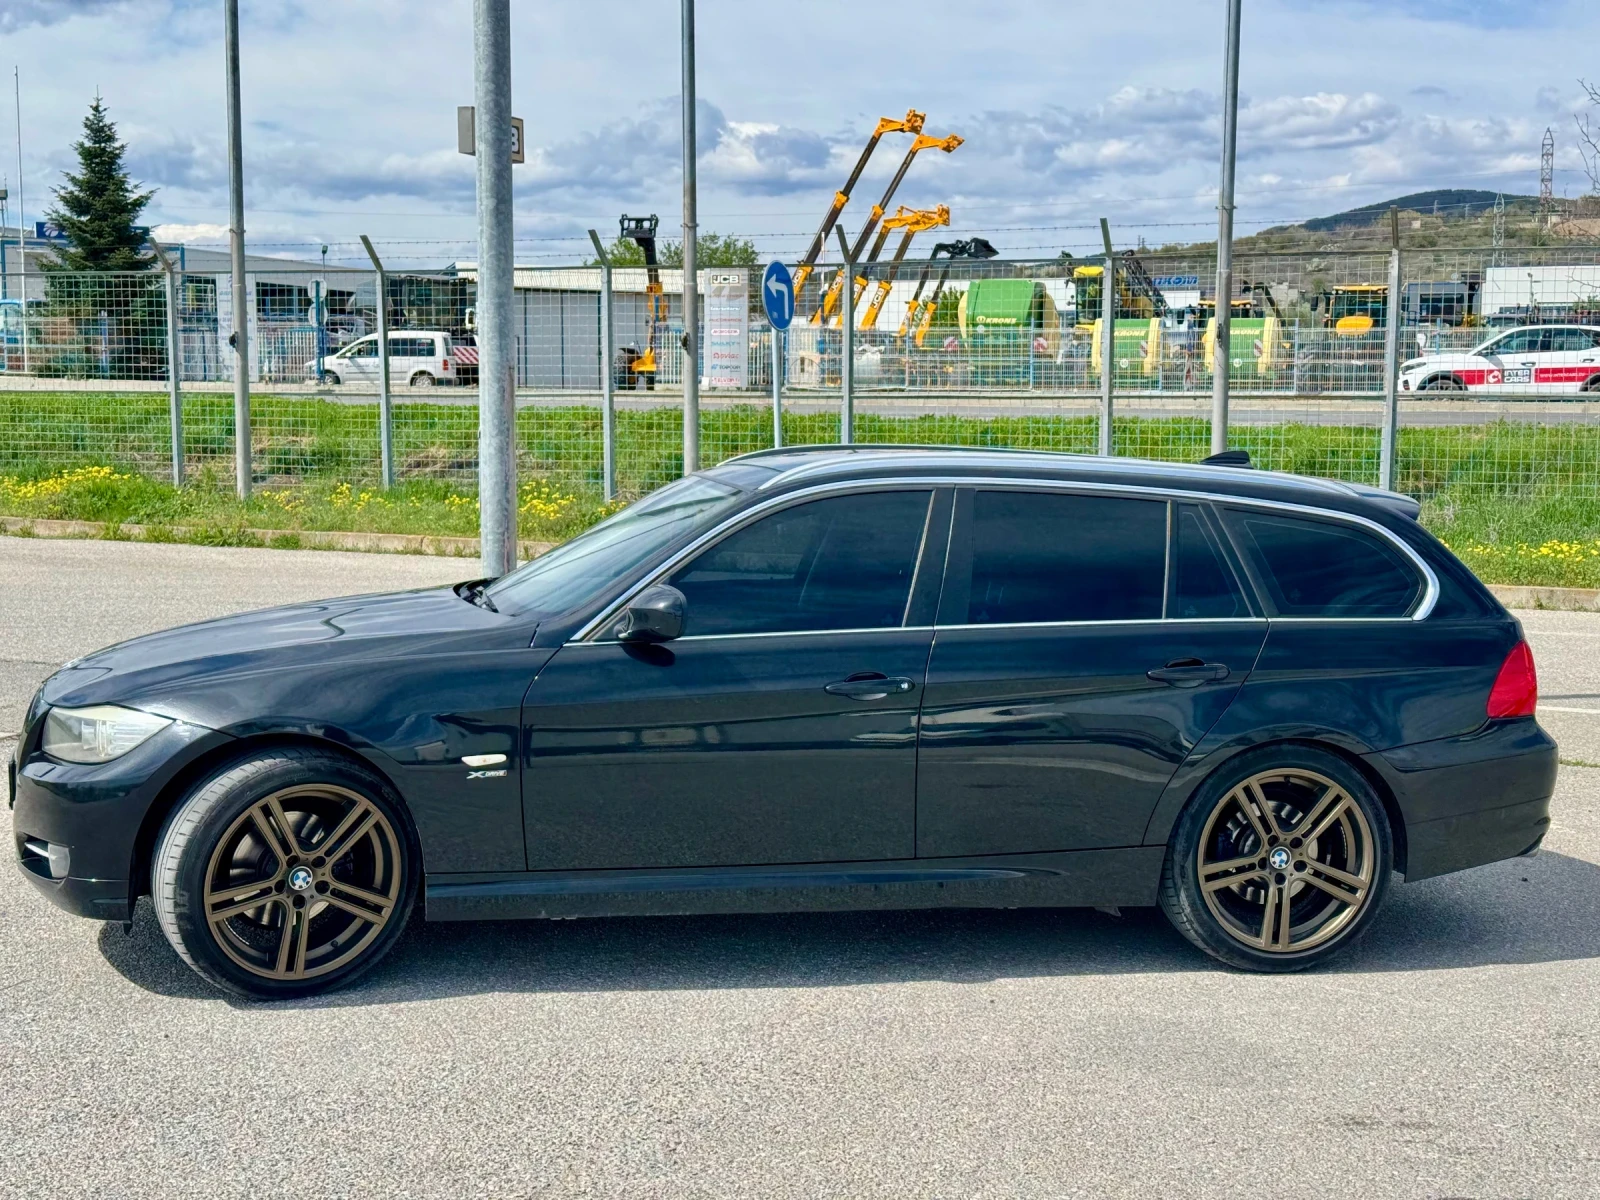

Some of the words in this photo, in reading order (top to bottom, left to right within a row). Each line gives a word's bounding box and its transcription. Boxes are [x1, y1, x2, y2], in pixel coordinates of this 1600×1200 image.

[712, 275, 739, 284] JCB
[793, 269, 804, 287] JCB
[831, 276, 843, 292] JCB
[872, 288, 885, 308] JCB
